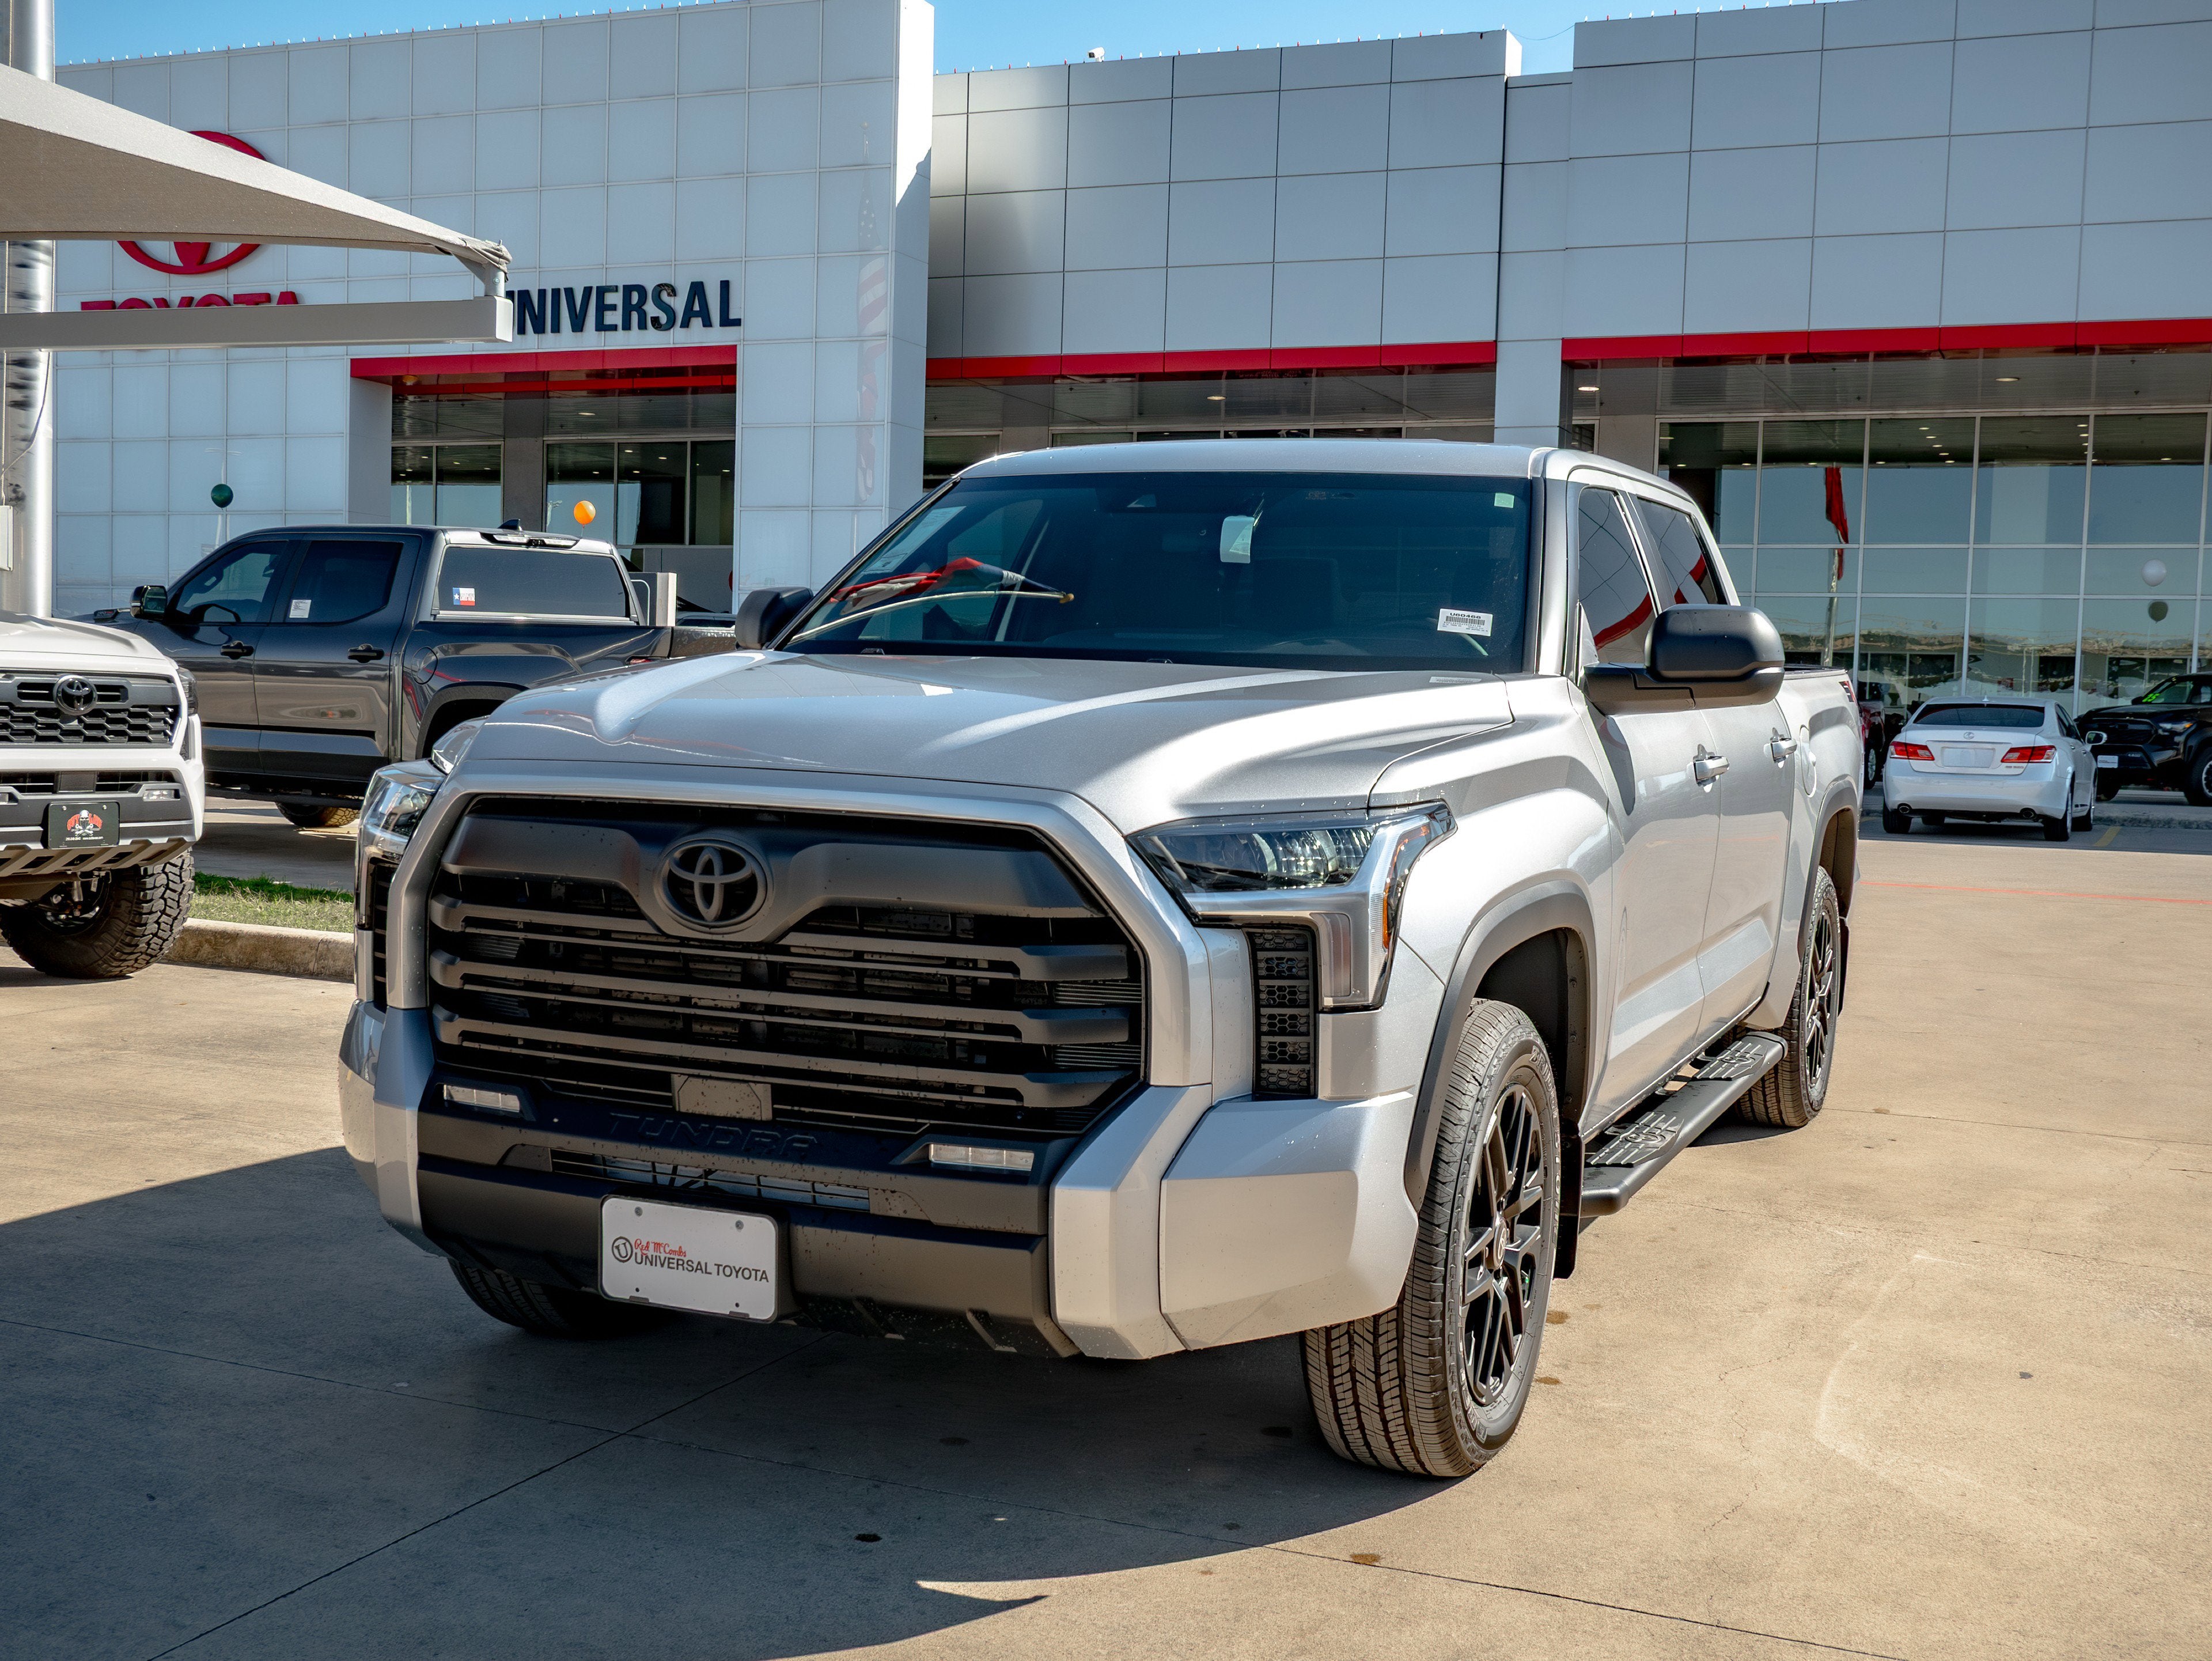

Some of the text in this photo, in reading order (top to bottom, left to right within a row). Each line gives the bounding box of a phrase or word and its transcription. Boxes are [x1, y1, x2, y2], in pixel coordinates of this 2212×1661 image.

[506, 279, 741, 335] NIVERSAL
[2142, 693, 2161, 702] 25
[609, 1112, 820, 1158] TUNDRA
[634, 1239, 649, 1255] Red
[634, 1251, 770, 1282] UNIVERSAL TOYOTA
